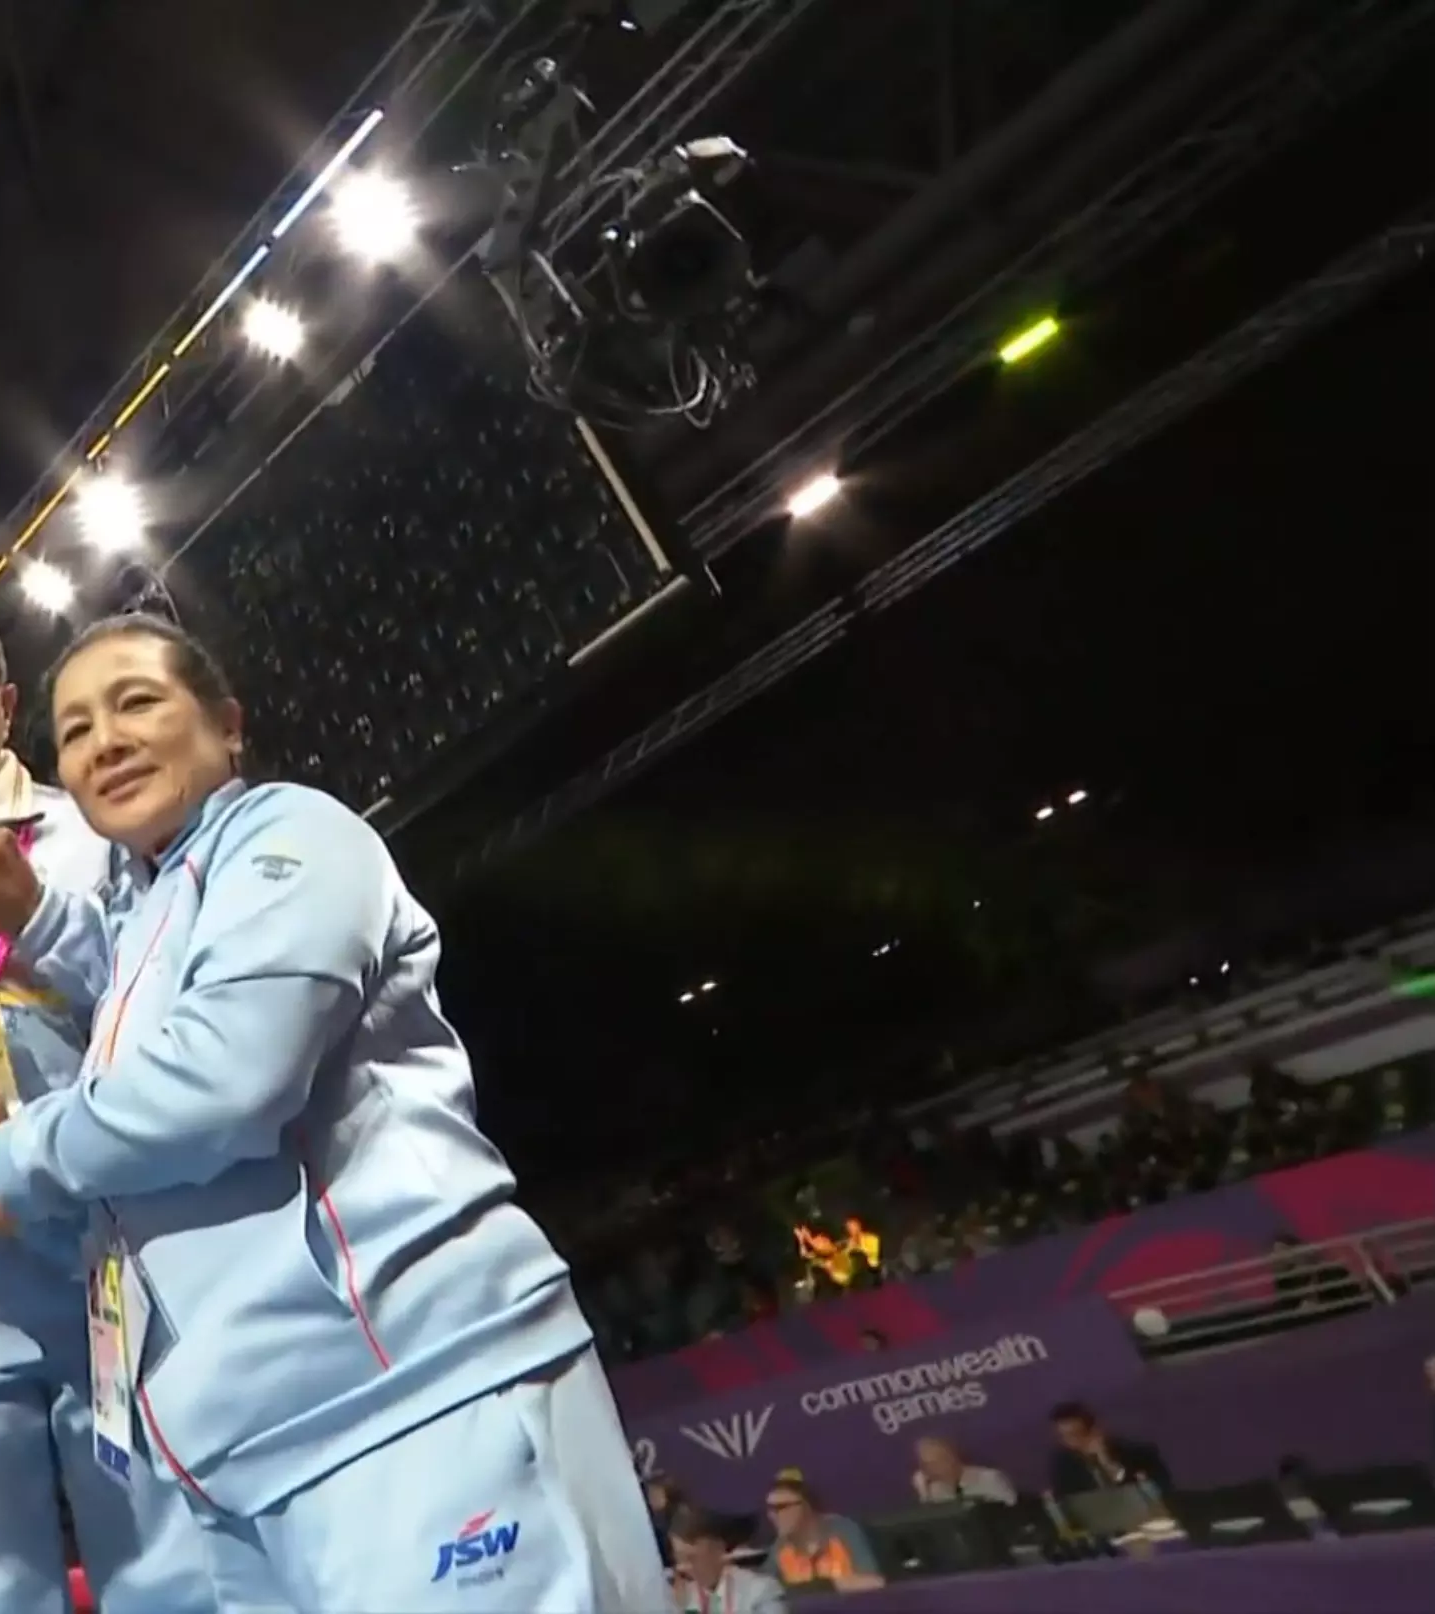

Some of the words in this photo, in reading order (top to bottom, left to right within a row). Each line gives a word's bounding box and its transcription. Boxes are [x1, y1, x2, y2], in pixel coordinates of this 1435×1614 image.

[801, 1332, 1047, 1416] commonwealth
[872, 1380, 987, 1434] games
[431, 1520, 520, 1582] JSW
